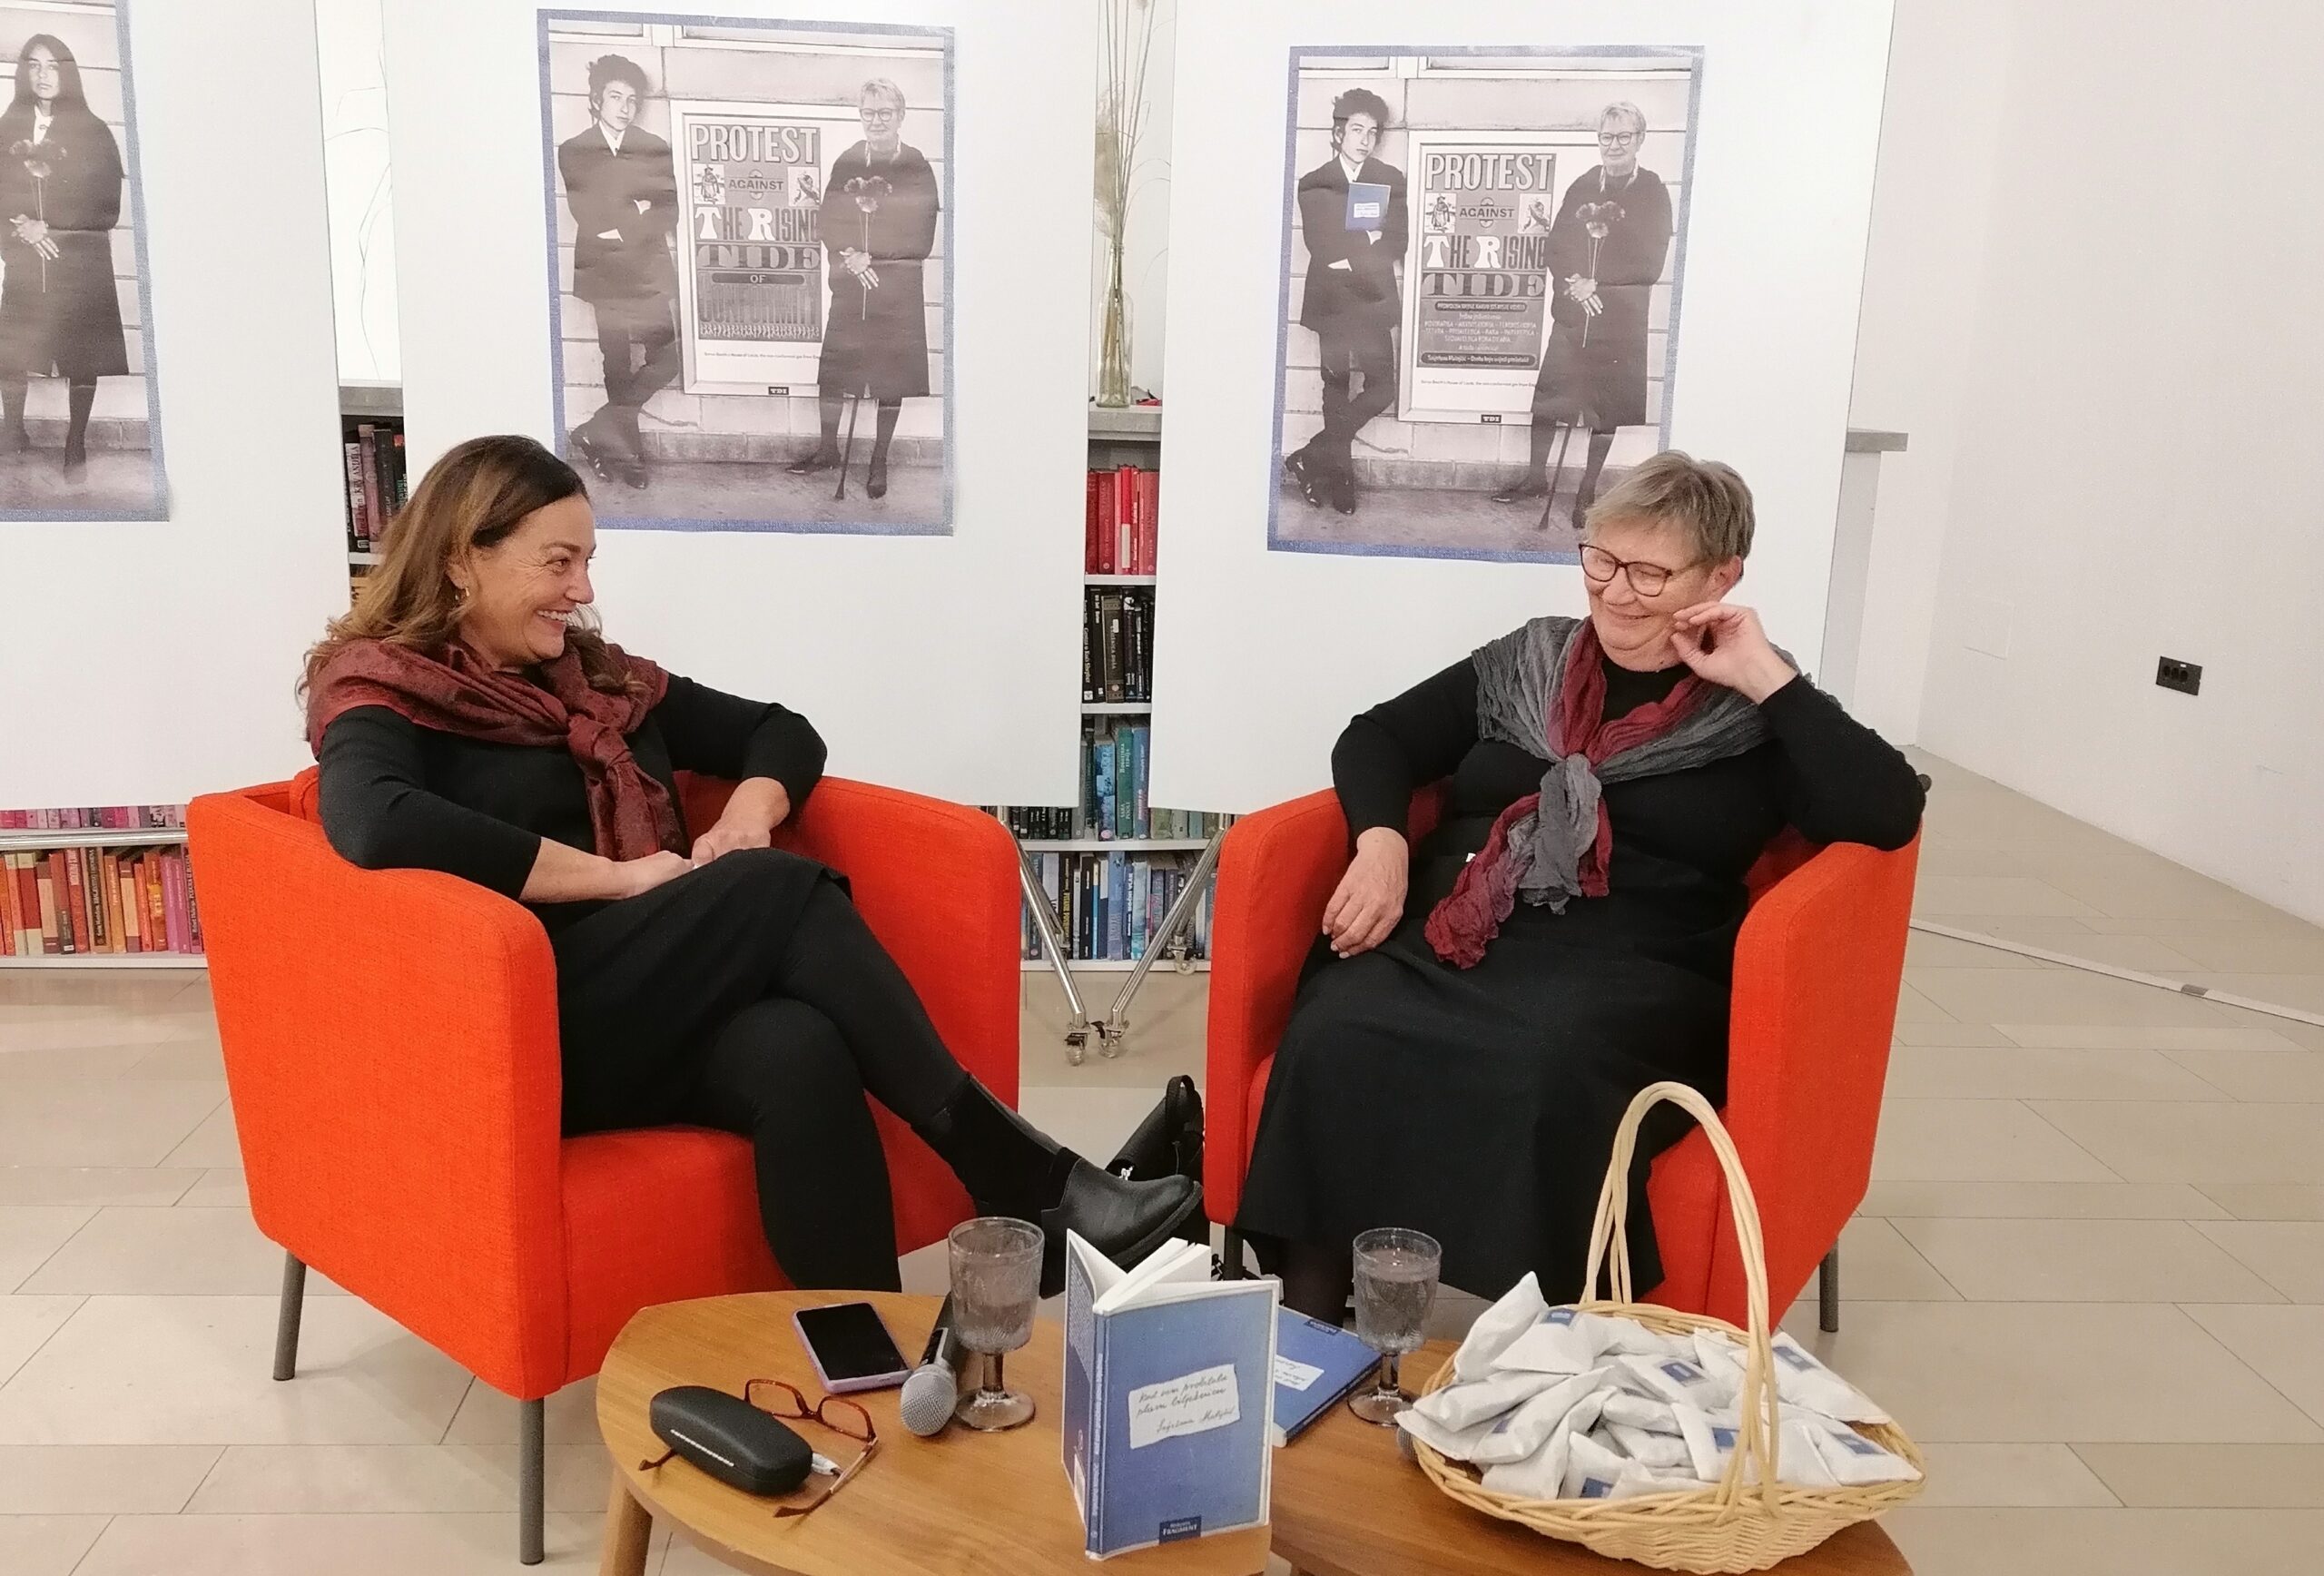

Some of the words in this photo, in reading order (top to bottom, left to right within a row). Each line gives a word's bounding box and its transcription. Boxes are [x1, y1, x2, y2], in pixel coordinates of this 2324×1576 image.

[690, 124, 817, 163] PROTEST
[1425, 153, 1552, 191] PROTEST
[728, 180, 784, 190] AGAINST
[694, 207, 744, 240] THE
[1459, 208, 1514, 218] AGAINST
[696, 245, 821, 270] TIDE
[1423, 234, 1471, 268] THE
[750, 274, 766, 283] OF
[1422, 273, 1545, 297] TIDE
